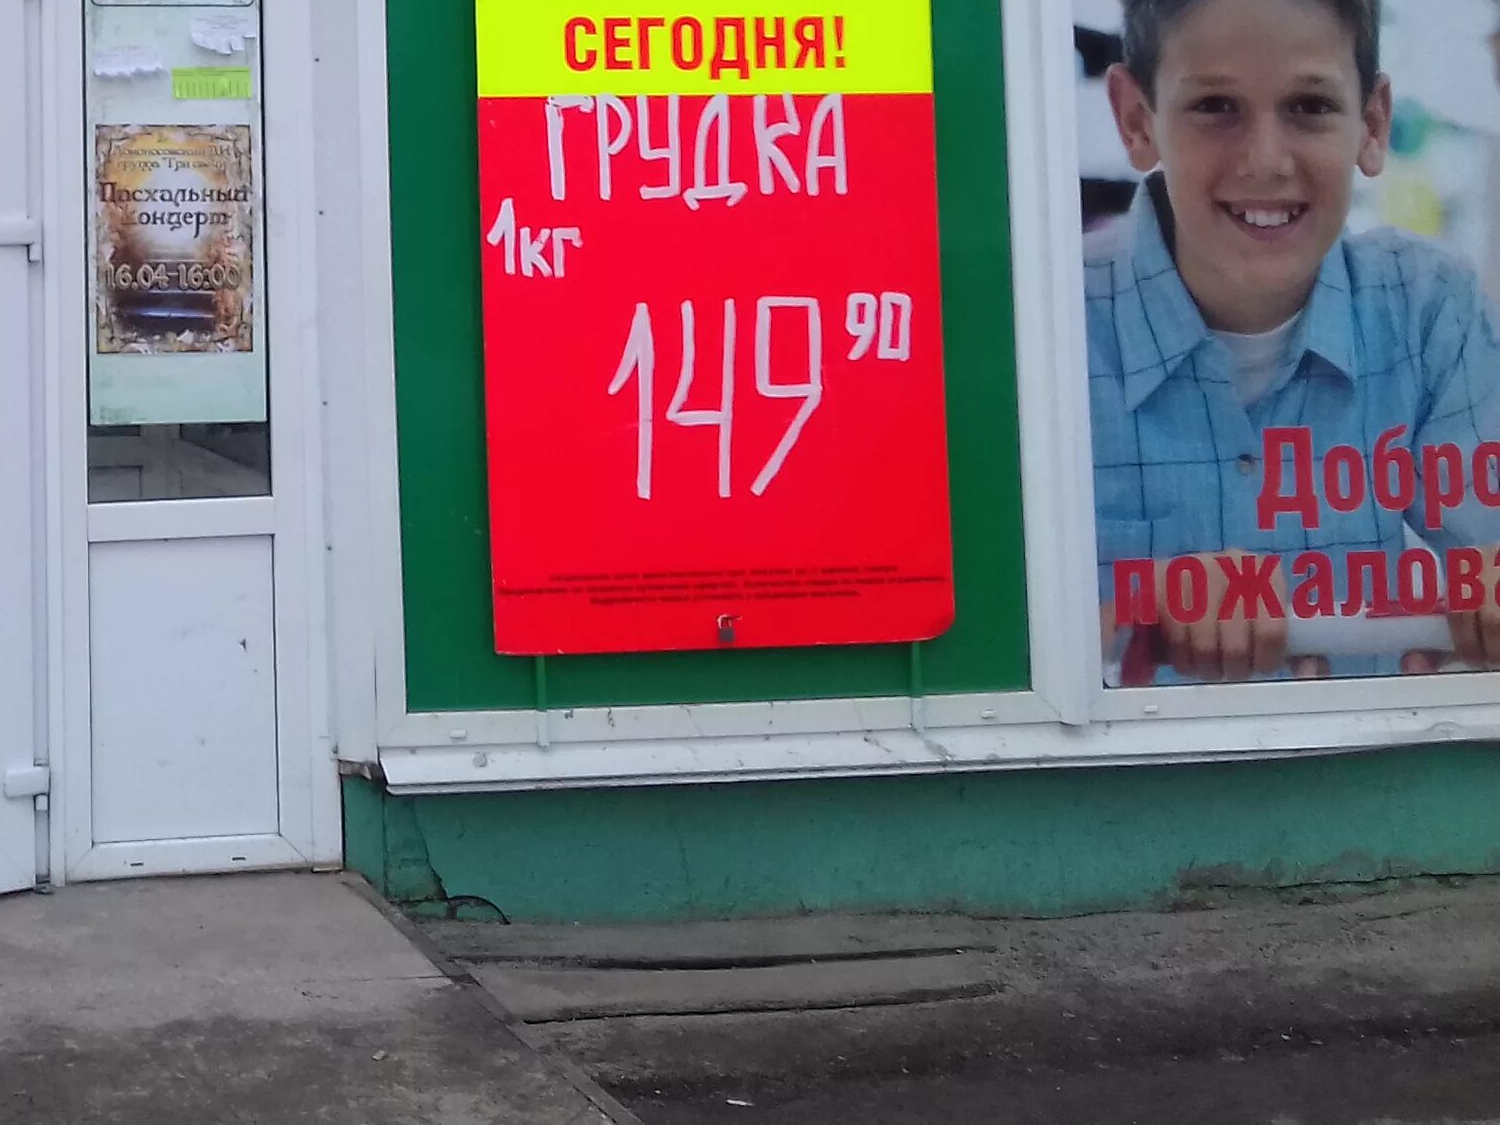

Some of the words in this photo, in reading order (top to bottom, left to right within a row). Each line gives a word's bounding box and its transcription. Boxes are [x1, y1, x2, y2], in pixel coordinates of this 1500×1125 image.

[563, 15, 847, 81] СЕГОДНЯ!
[545, 92, 848, 210] ГРУДКА
[607, 295, 823, 501] 149
[845, 291, 913, 362] 90
[1256, 424, 1500, 531] Добро
[1113, 546, 1500, 626] пожалов
